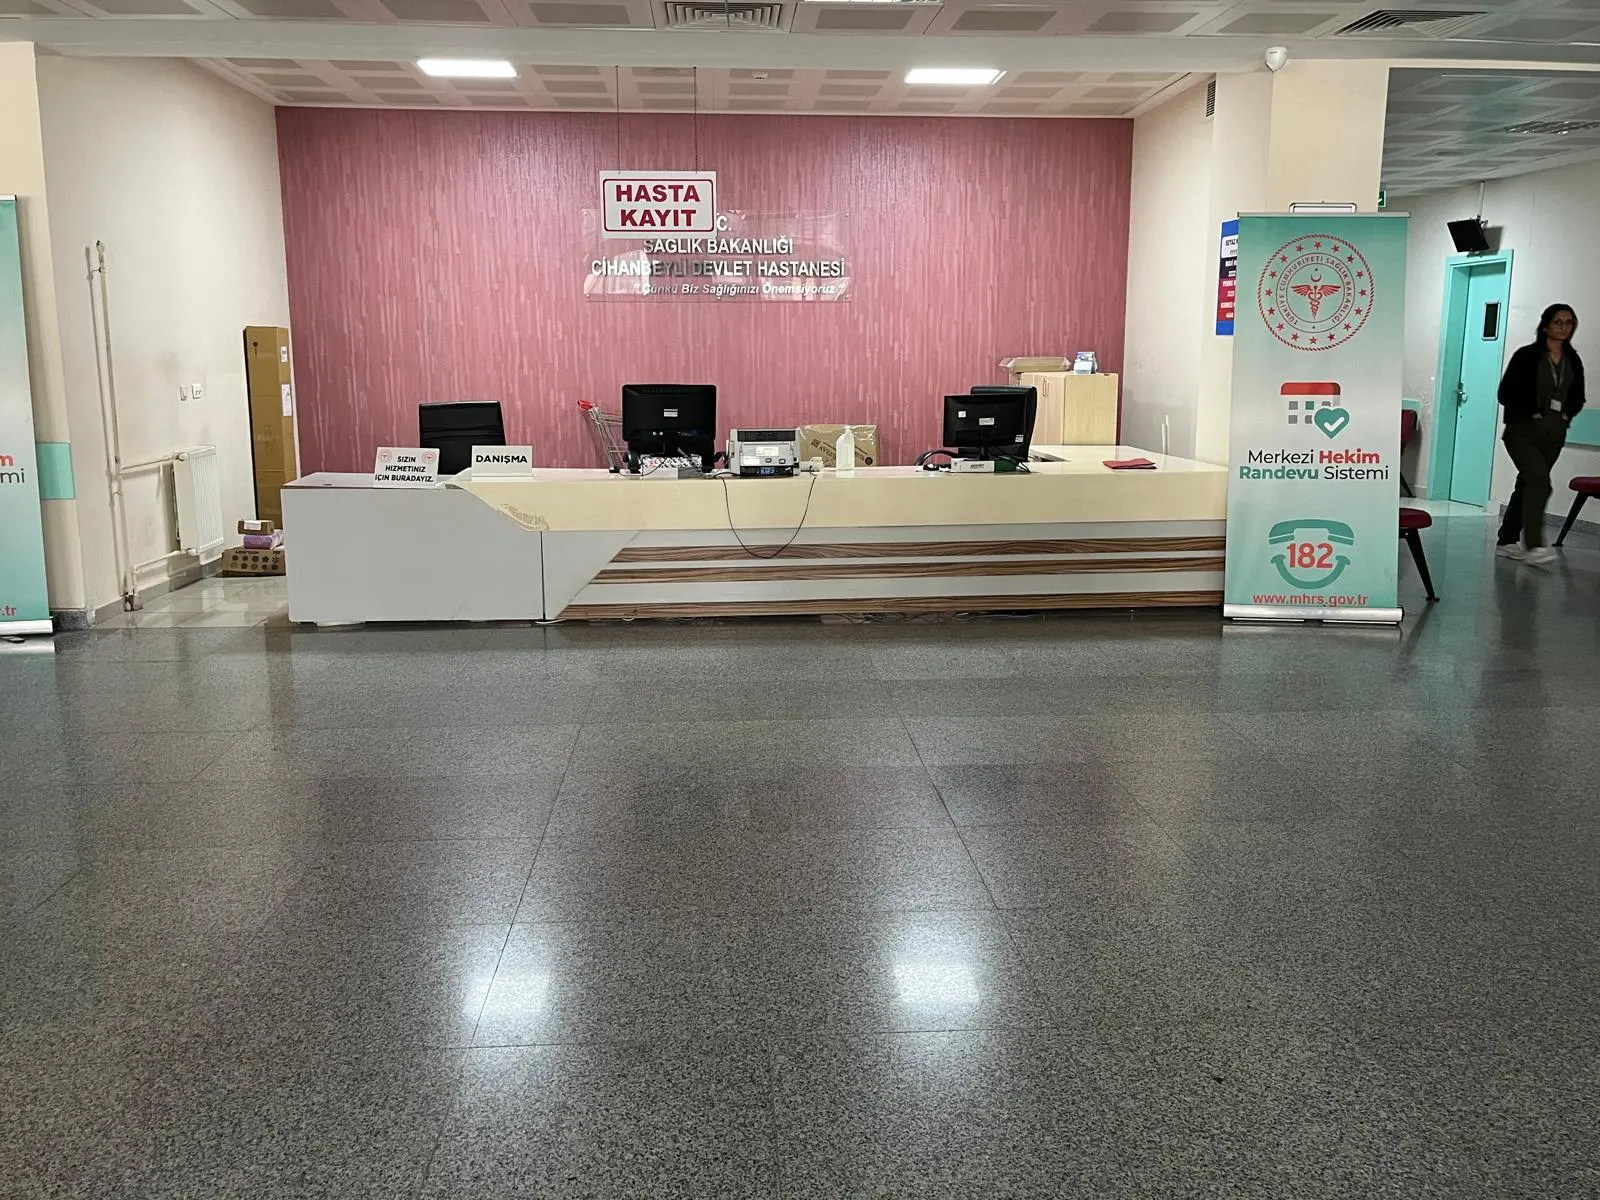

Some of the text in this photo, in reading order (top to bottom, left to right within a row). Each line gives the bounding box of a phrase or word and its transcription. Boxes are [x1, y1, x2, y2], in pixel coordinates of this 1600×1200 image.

[615, 184, 701, 203] HASTA
[620, 209, 697, 227] KAYIT
[707, 235, 793, 254] BAKANLIĞI
[692, 260, 753, 276] DEVLET
[757, 257, 845, 277] HASTANESİ
[681, 283, 699, 294] Biz
[475, 455, 528, 464] DANIŞMA
[1248, 448, 1380, 464] Merkezi Hekim
[1239, 465, 1389, 480] Randevu Sistemi
[1286, 543, 1334, 568] 182
[1253, 593, 1368, 607] www.mhrs.gov.tr
